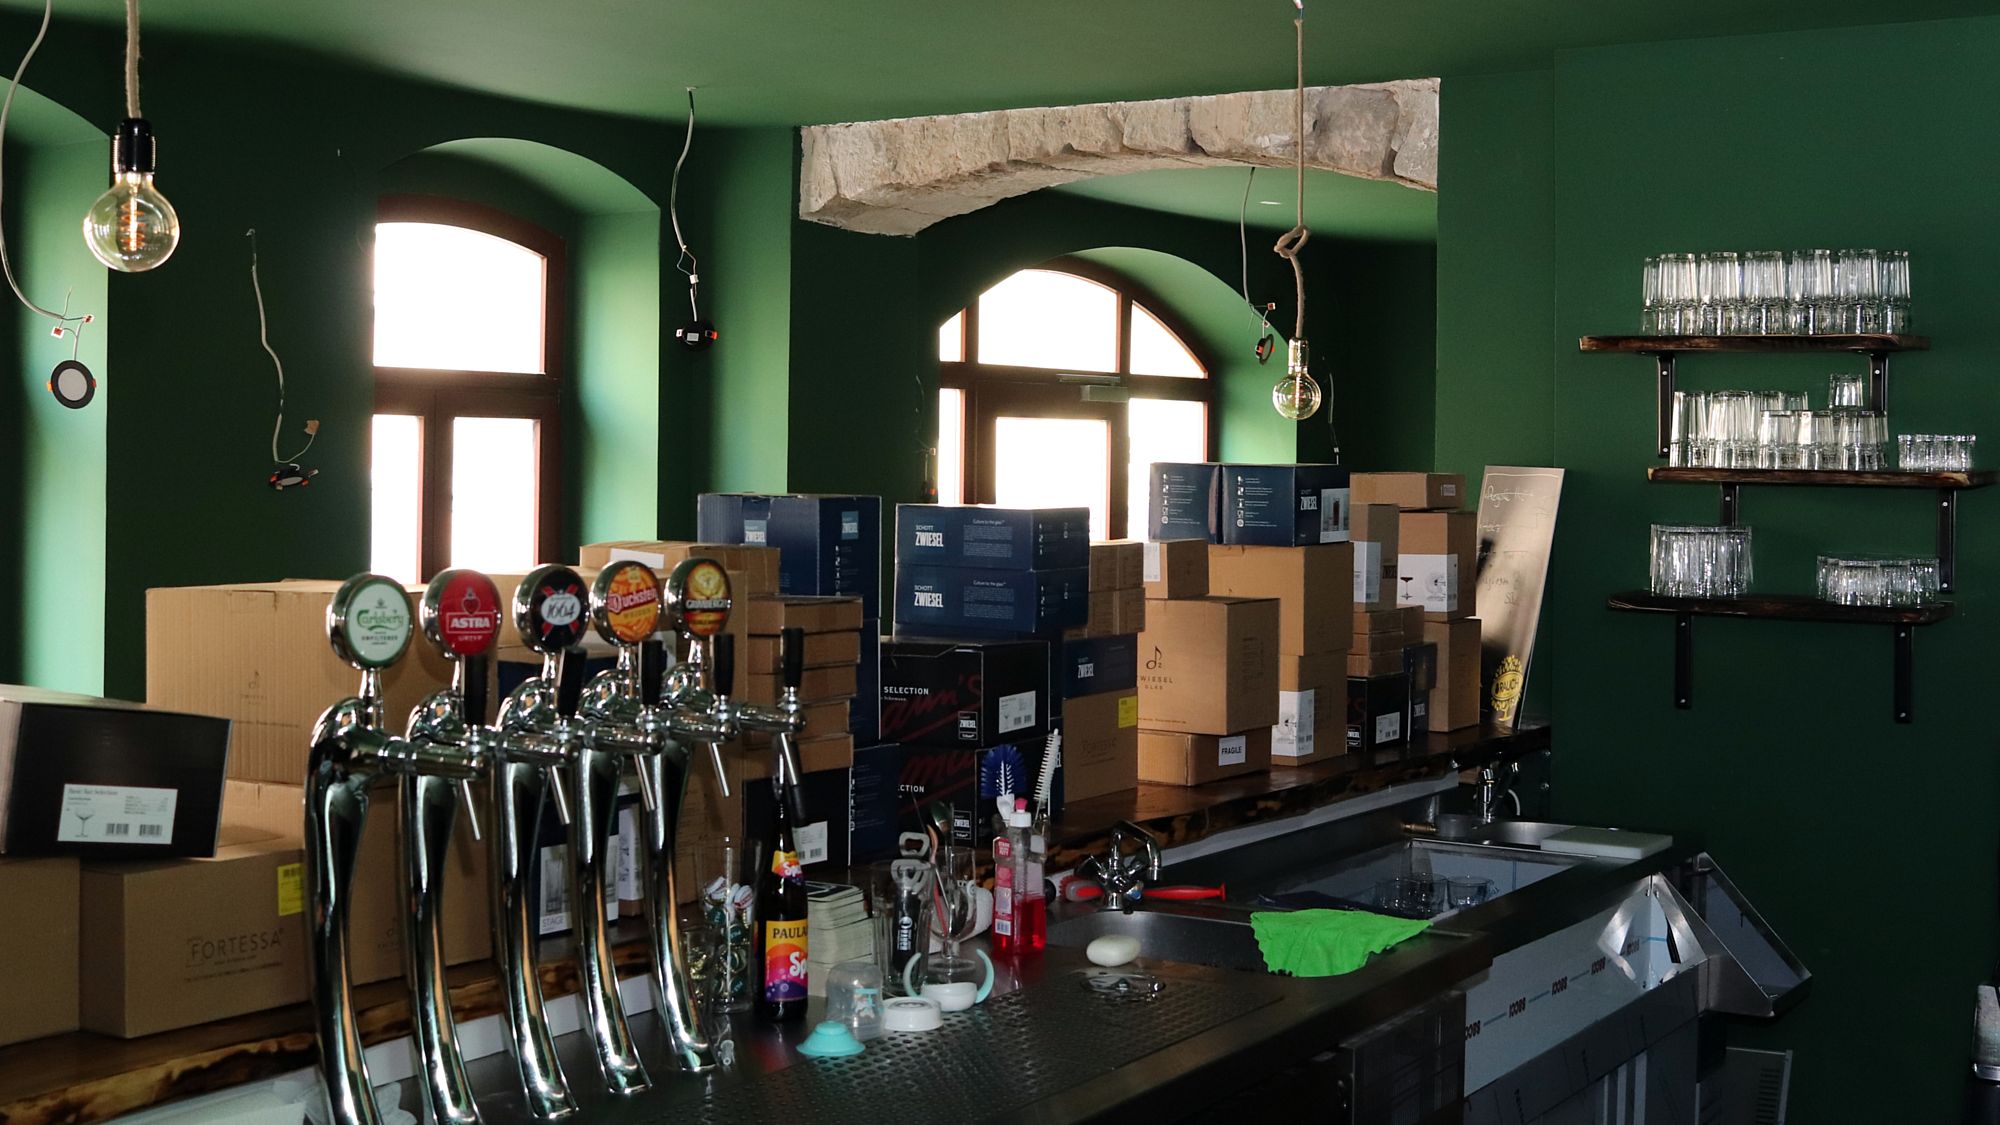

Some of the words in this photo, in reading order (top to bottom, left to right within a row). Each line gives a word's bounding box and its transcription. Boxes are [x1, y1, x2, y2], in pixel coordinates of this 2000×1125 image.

[915, 532, 944, 547] ZWIESEL
[913, 592, 944, 608] ZWIESEL
[546, 603, 576, 619] 1664
[357, 609, 405, 631] Carlsberg
[449, 617, 491, 629] ASTRA
[1139, 676, 1174, 684] WIESEL
[883, 686, 929, 695] SELECTION
[1221, 746, 1242, 755] FRAGILE
